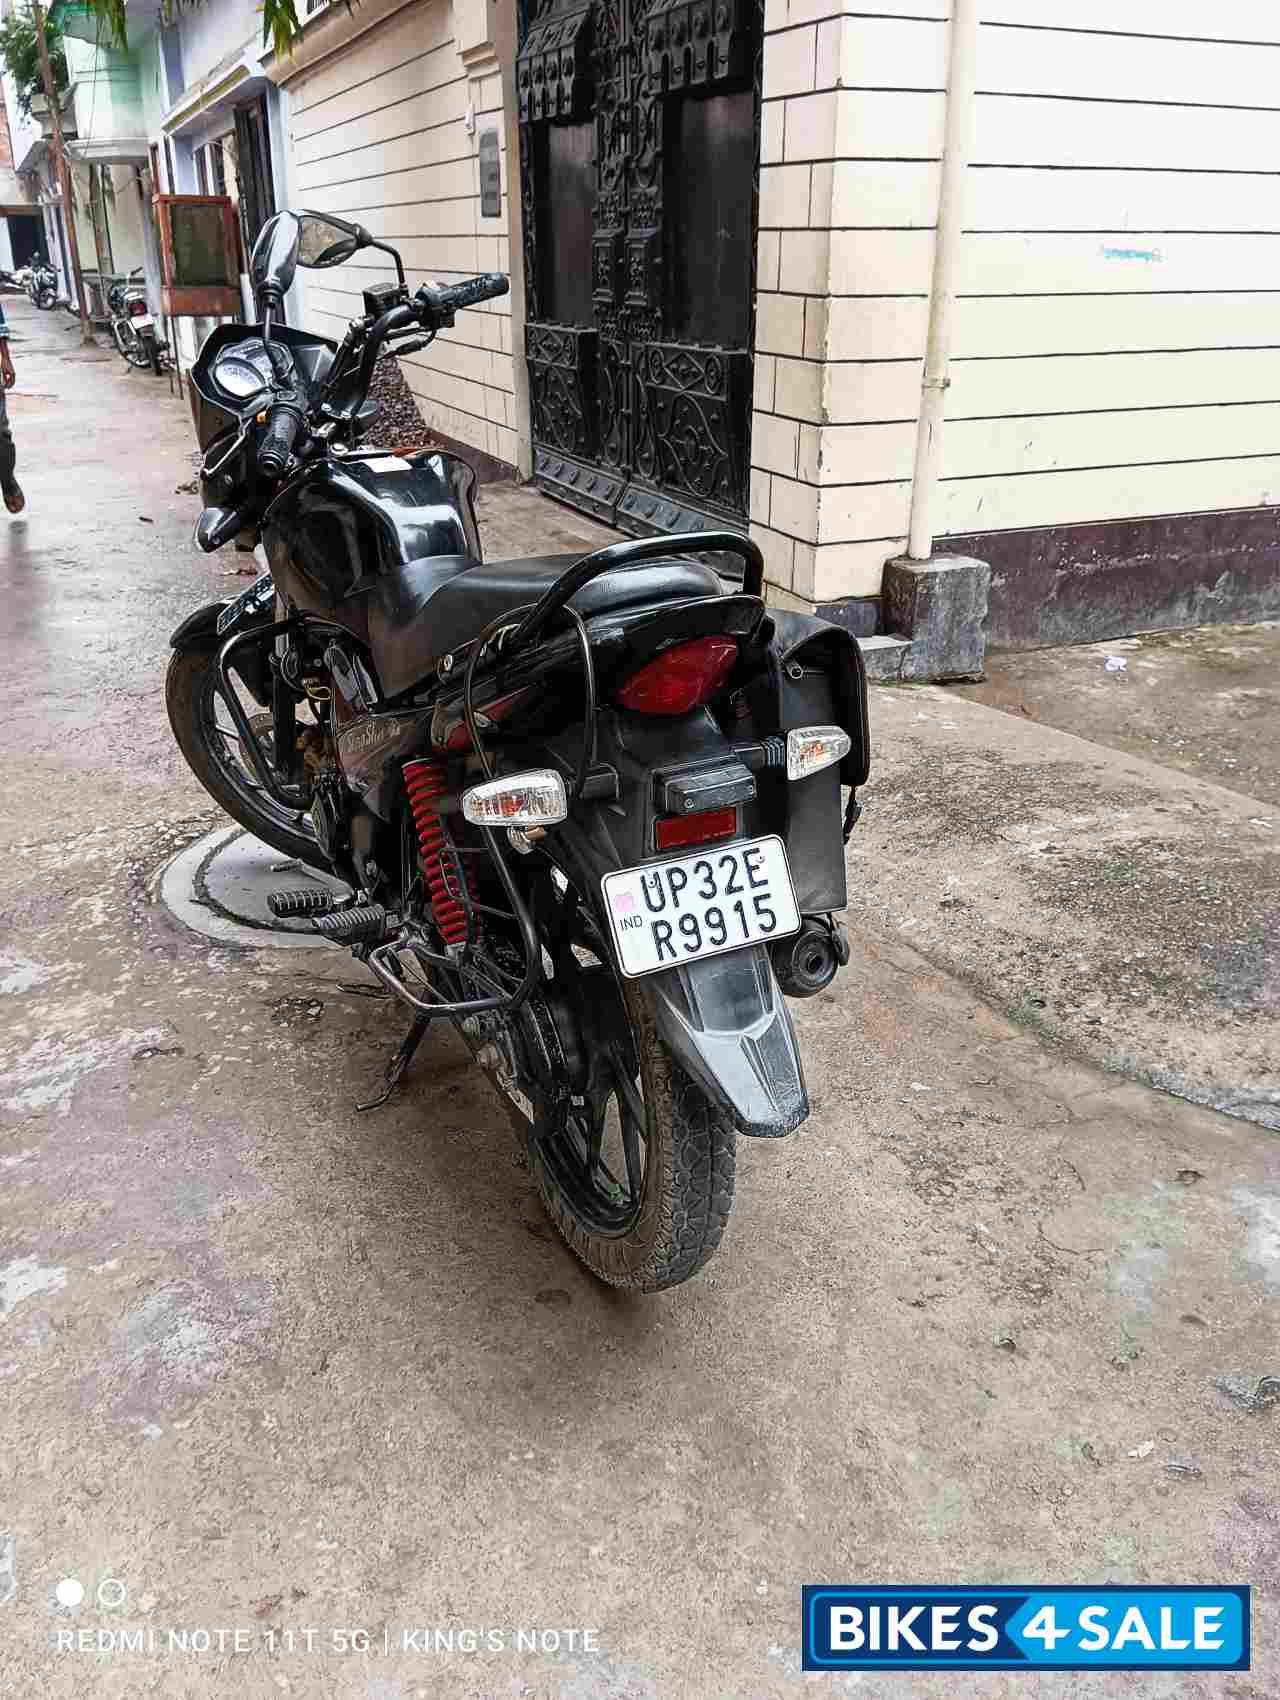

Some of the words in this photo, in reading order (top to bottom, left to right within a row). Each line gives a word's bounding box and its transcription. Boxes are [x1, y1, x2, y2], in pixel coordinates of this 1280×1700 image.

[640, 848, 769, 912] UP32E
[619, 915, 643, 931] IND
[652, 893, 777, 961] R9915
